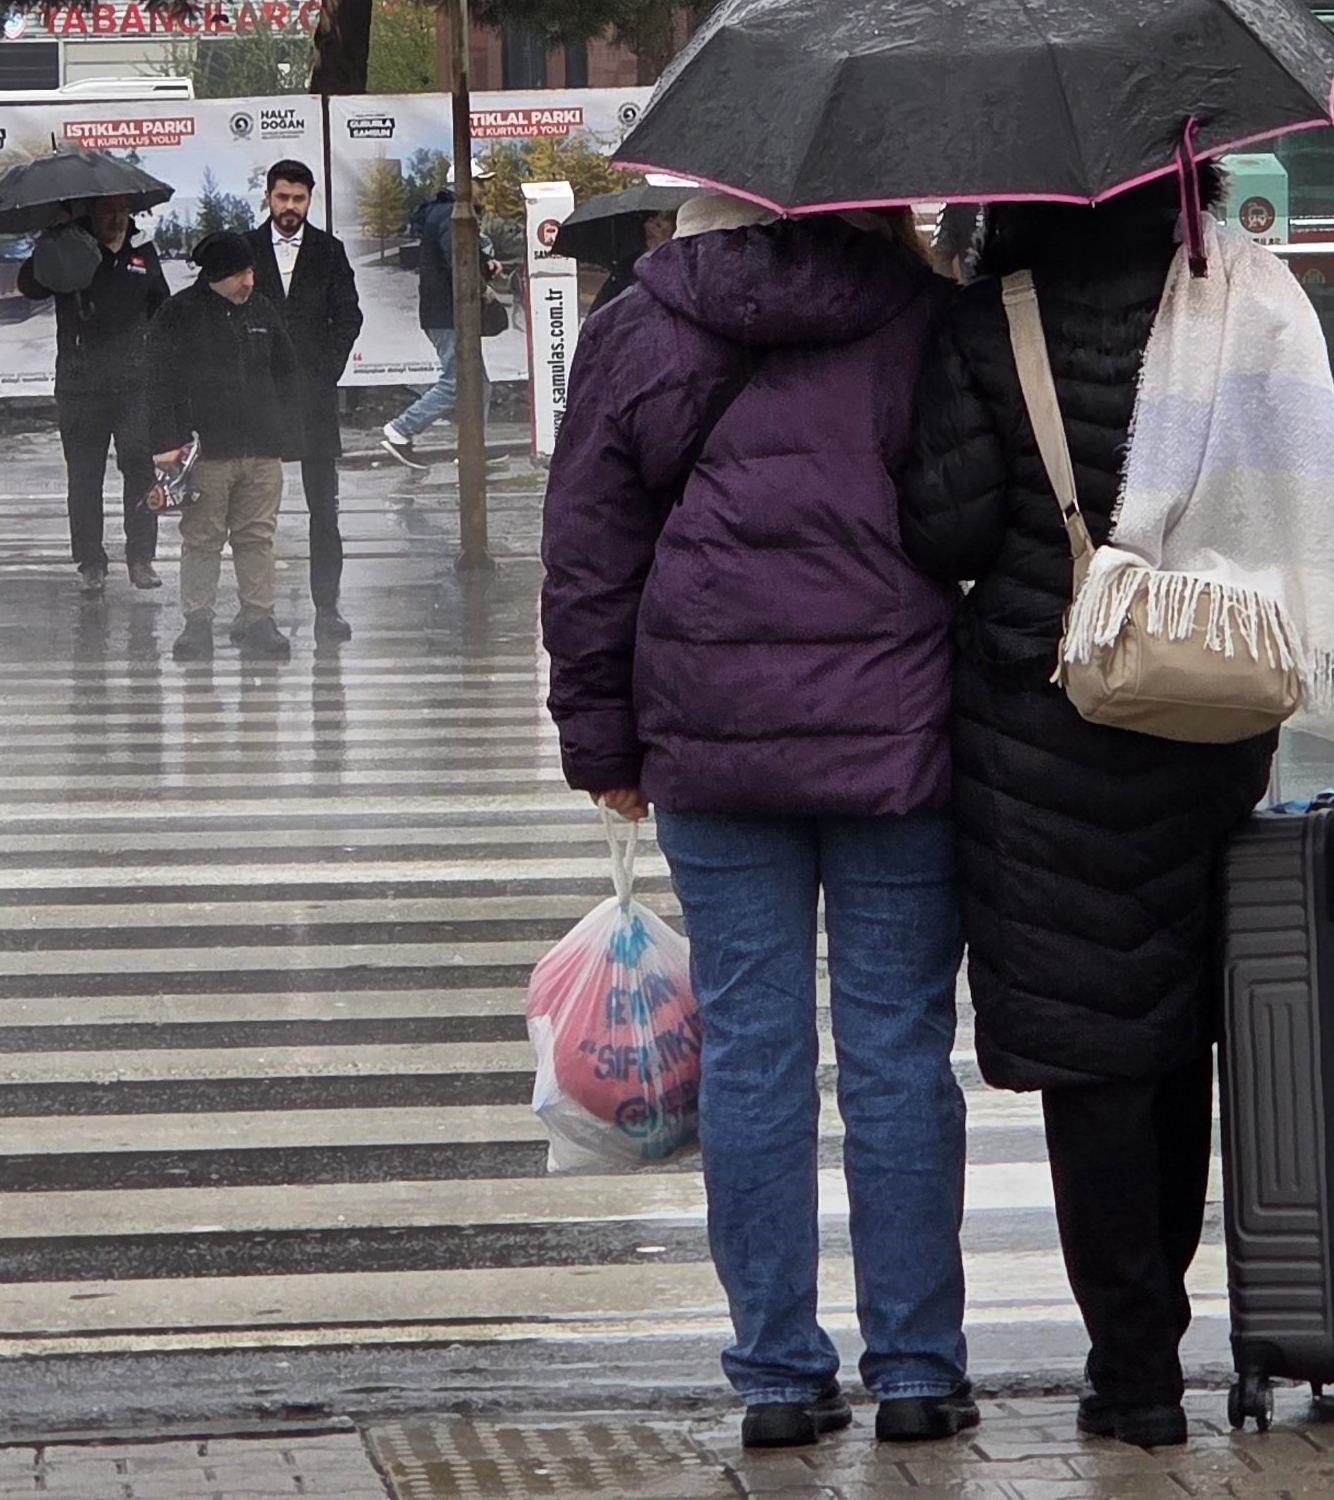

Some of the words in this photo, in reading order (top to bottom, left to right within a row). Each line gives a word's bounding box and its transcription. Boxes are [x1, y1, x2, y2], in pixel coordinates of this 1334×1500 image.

[540, 124, 567, 135] YOLU
[81, 138, 96, 148] VE
[150, 134, 179, 144] YOLU
